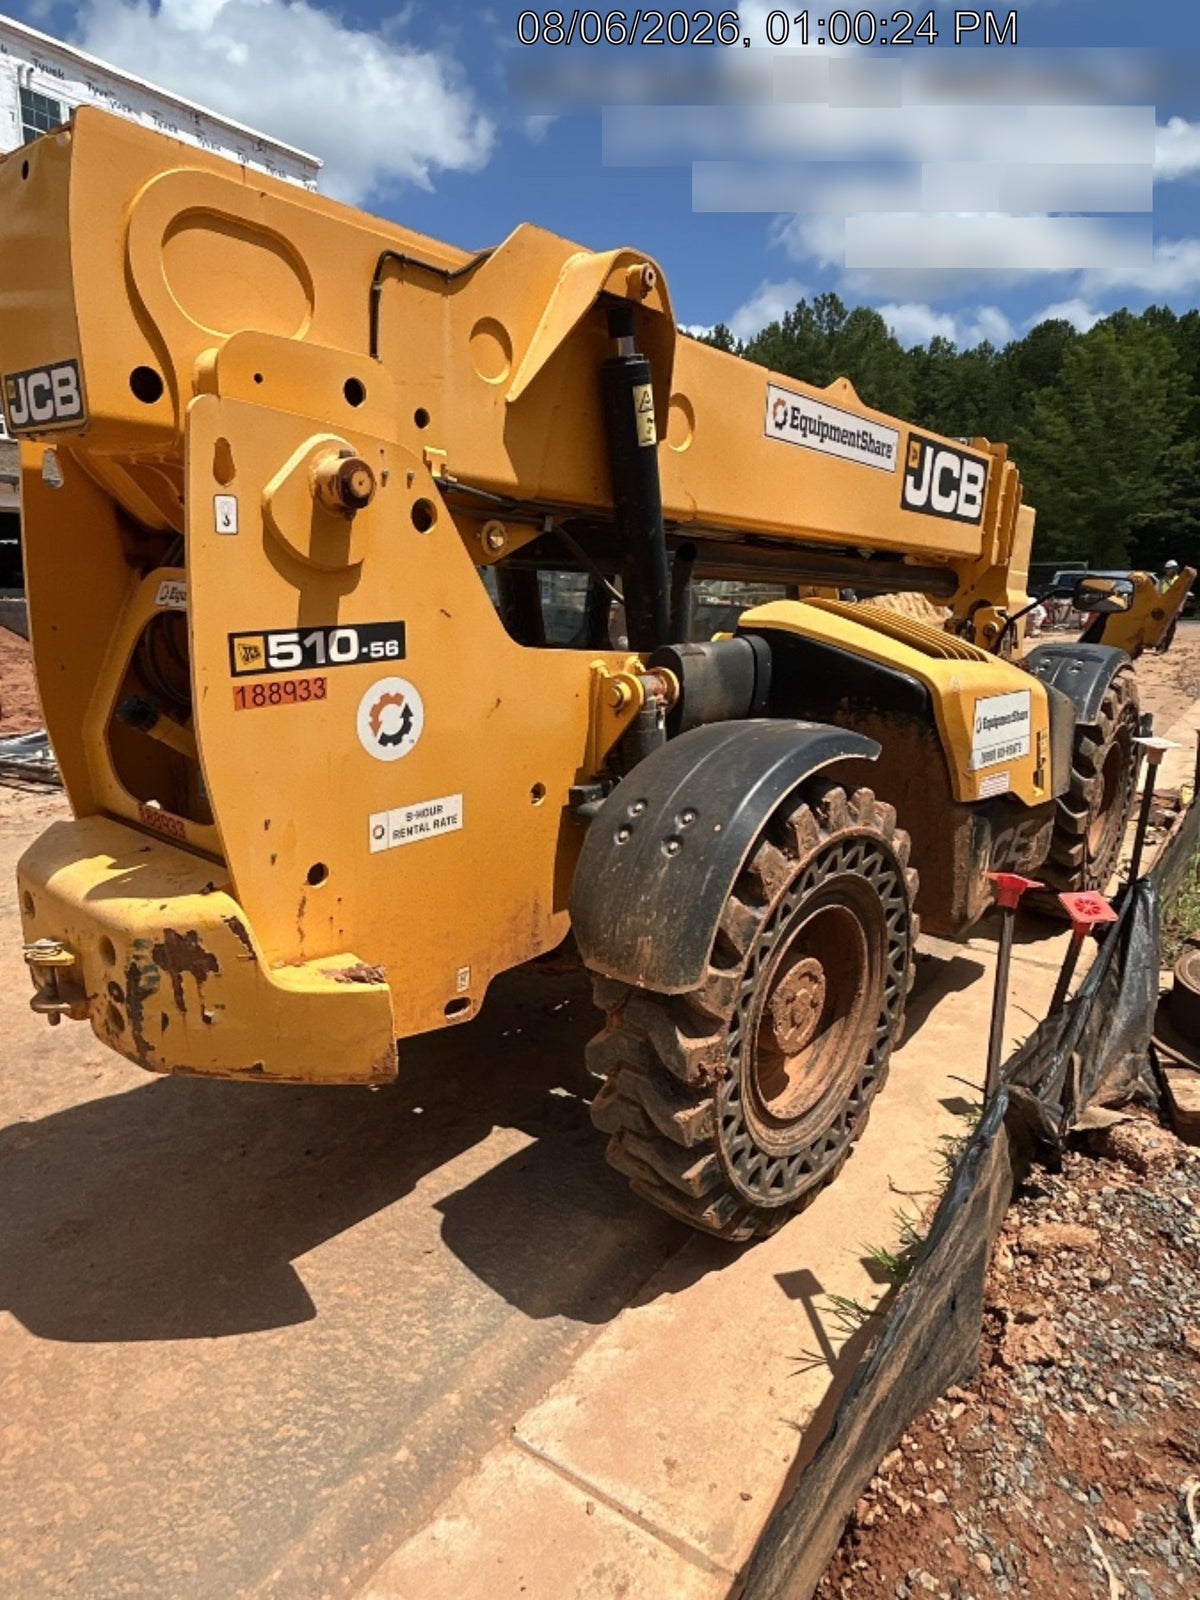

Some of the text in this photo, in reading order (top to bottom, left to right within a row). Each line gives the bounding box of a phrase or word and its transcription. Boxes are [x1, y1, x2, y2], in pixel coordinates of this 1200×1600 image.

[9, 366, 81, 424] JCB
[789, 406, 893, 459] EquipmentShare
[904, 445, 986, 518] JCB
[267, 628, 399, 669] 510-56
[236, 677, 327, 708] 188933
[392, 814, 458, 840] RENTAL RATE
